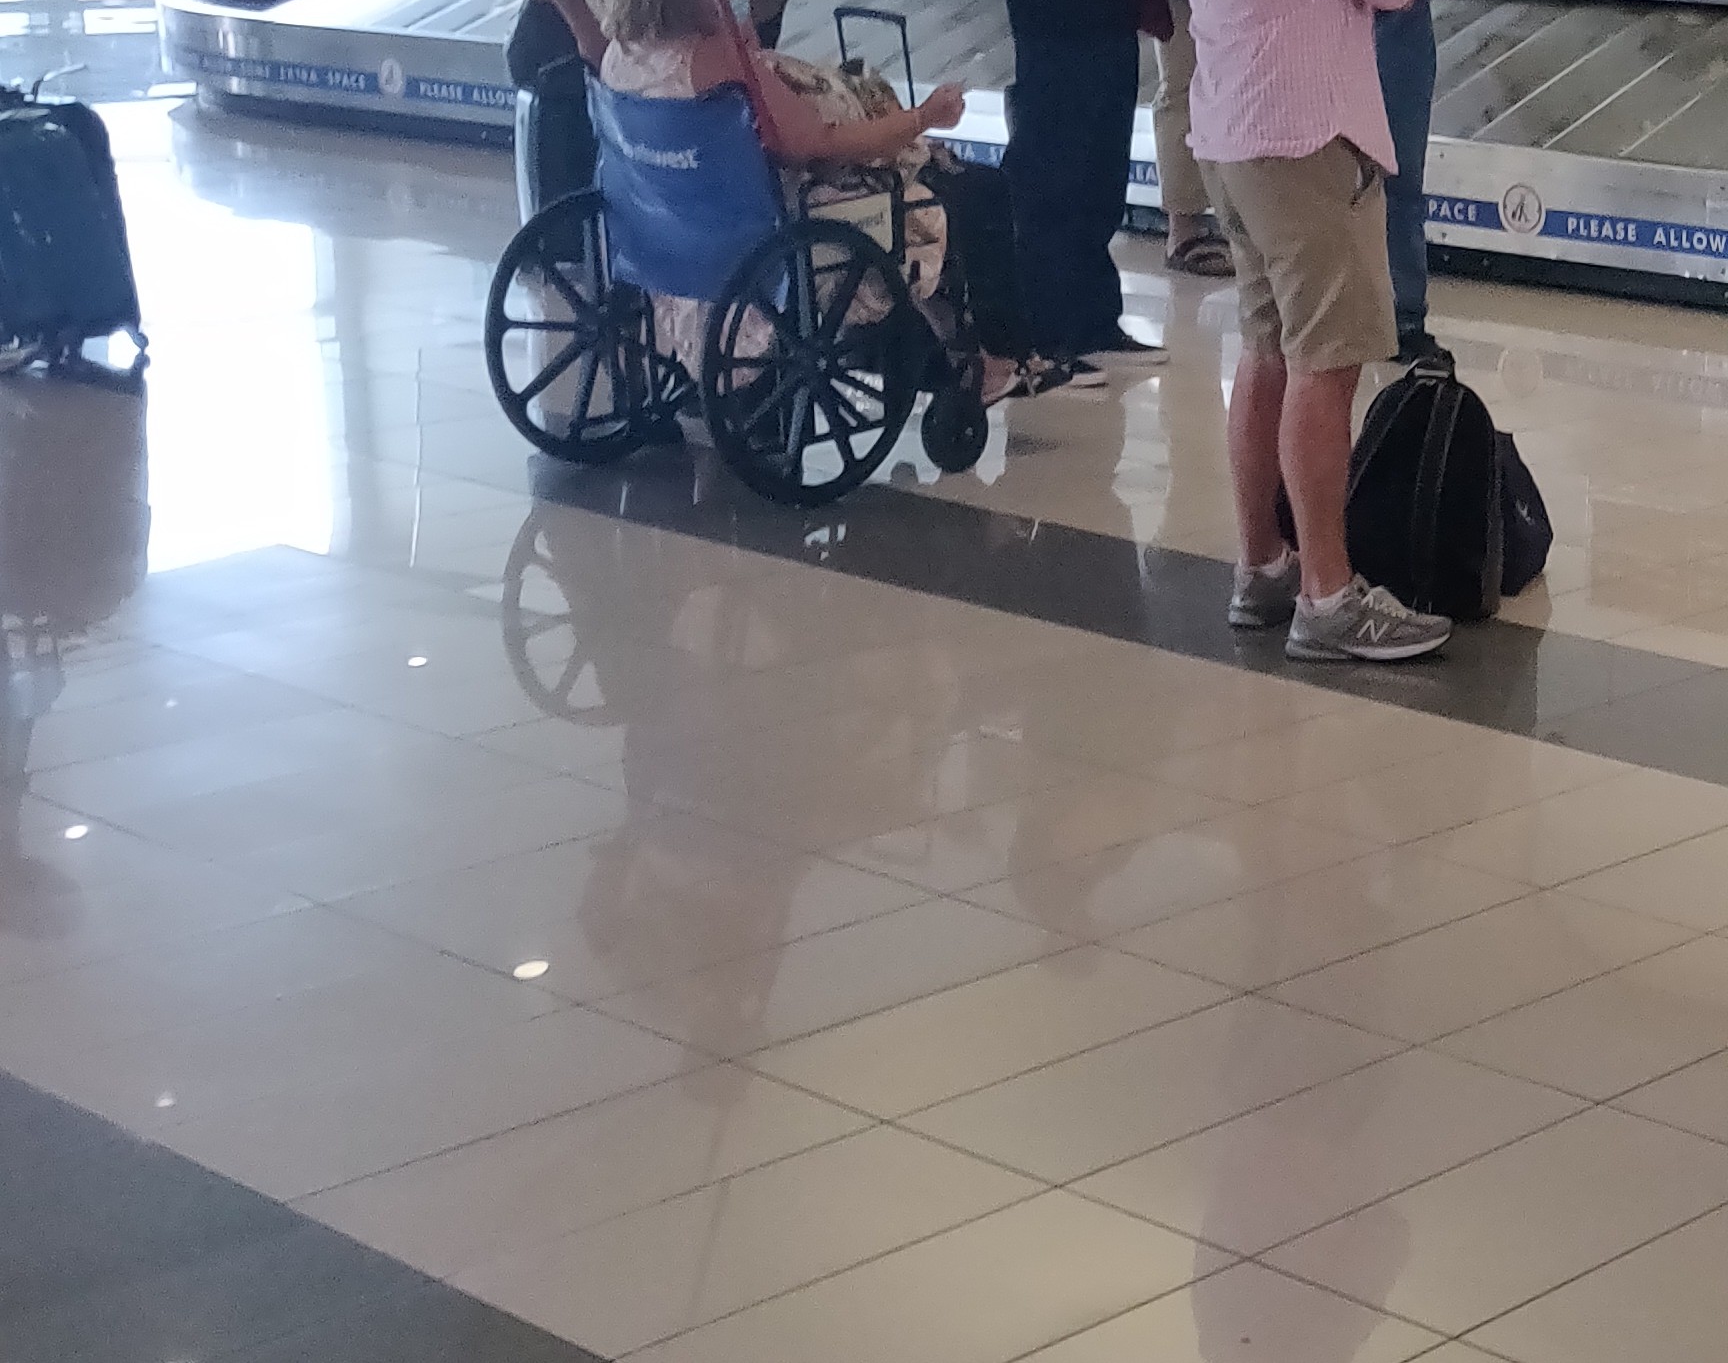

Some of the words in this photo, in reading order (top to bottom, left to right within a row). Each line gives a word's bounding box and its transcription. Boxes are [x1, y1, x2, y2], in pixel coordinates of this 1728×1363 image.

[327, 70, 366, 90] SPACE
[418, 80, 463, 102] PLEASE
[1427, 198, 1478, 222] PACE
[1567, 216, 1637, 242] PLEASE
[1653, 227, 1728, 253] ALLOW
